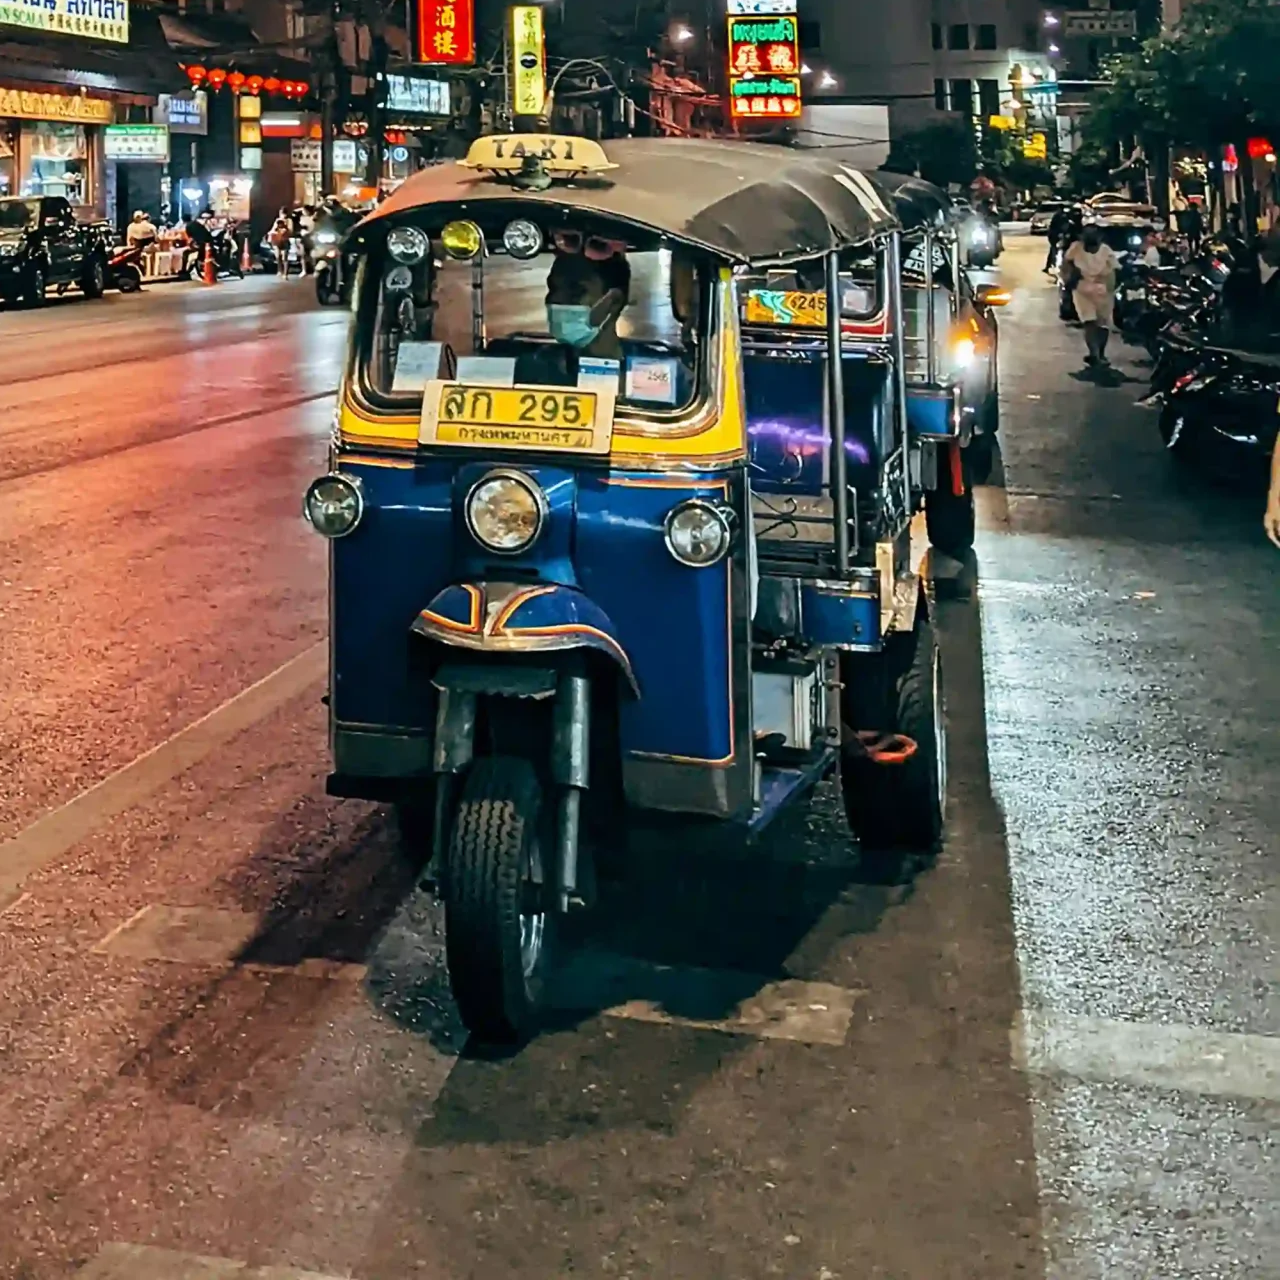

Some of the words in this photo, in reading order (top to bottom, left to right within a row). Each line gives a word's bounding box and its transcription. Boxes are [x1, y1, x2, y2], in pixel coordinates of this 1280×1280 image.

[13, 8, 44, 25] SCALA
[492, 138, 575, 160] TAXI
[518, 394, 582, 424] 295
